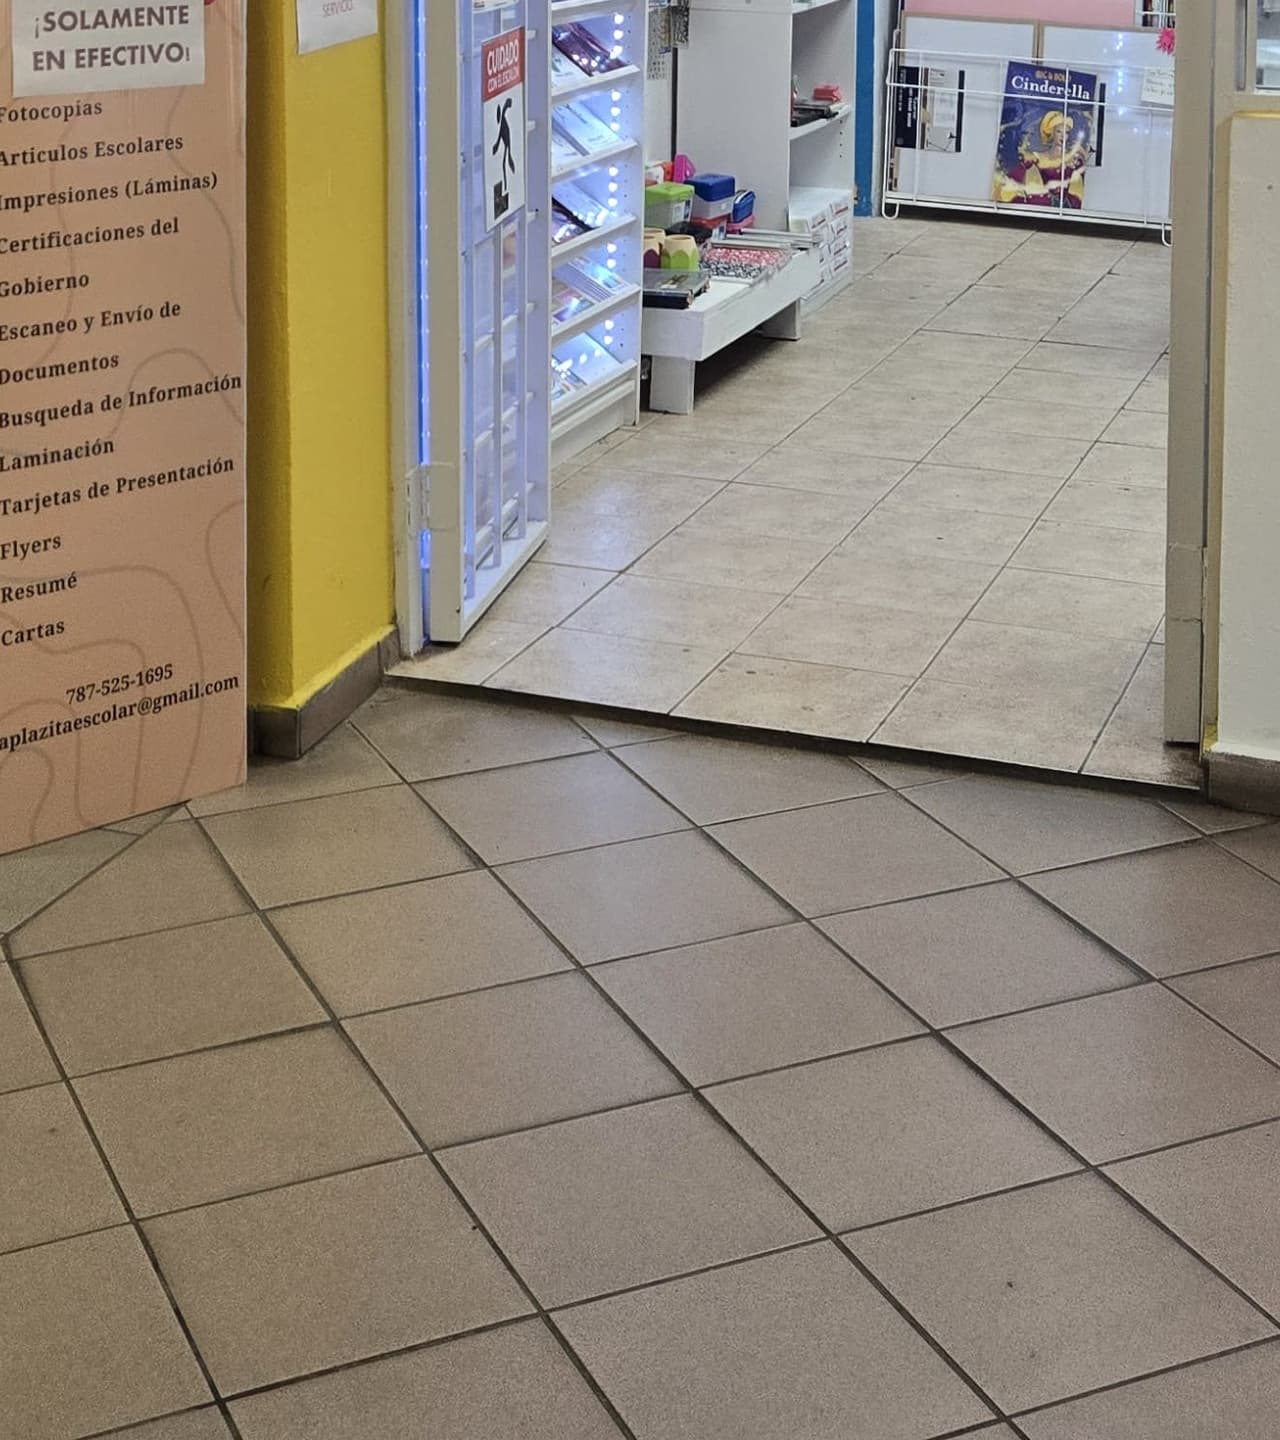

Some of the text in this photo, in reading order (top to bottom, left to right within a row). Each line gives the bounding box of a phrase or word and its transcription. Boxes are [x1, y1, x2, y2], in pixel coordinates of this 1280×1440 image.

[35, 5, 189, 38] ¡SOLAMENTE
[33, 50, 65, 71] EN
[487, 39, 519, 76] CUIDADO
[1012, 75, 1090, 99] Cinderella
[95, 135, 183, 158] Escolares
[125, 172, 218, 199] (Láminas)
[151, 217, 178, 236] del
[100, 396, 122, 410] de
[128, 374, 242, 407] Información
[88, 482, 109, 499] de
[116, 457, 234, 493] Presentación
[0, 535, 61, 561] Flyers
[0, 572, 77, 603] Resumé
[1, 620, 65, 646] Cartas
[66, 663, 173, 705] 787-525-1695
